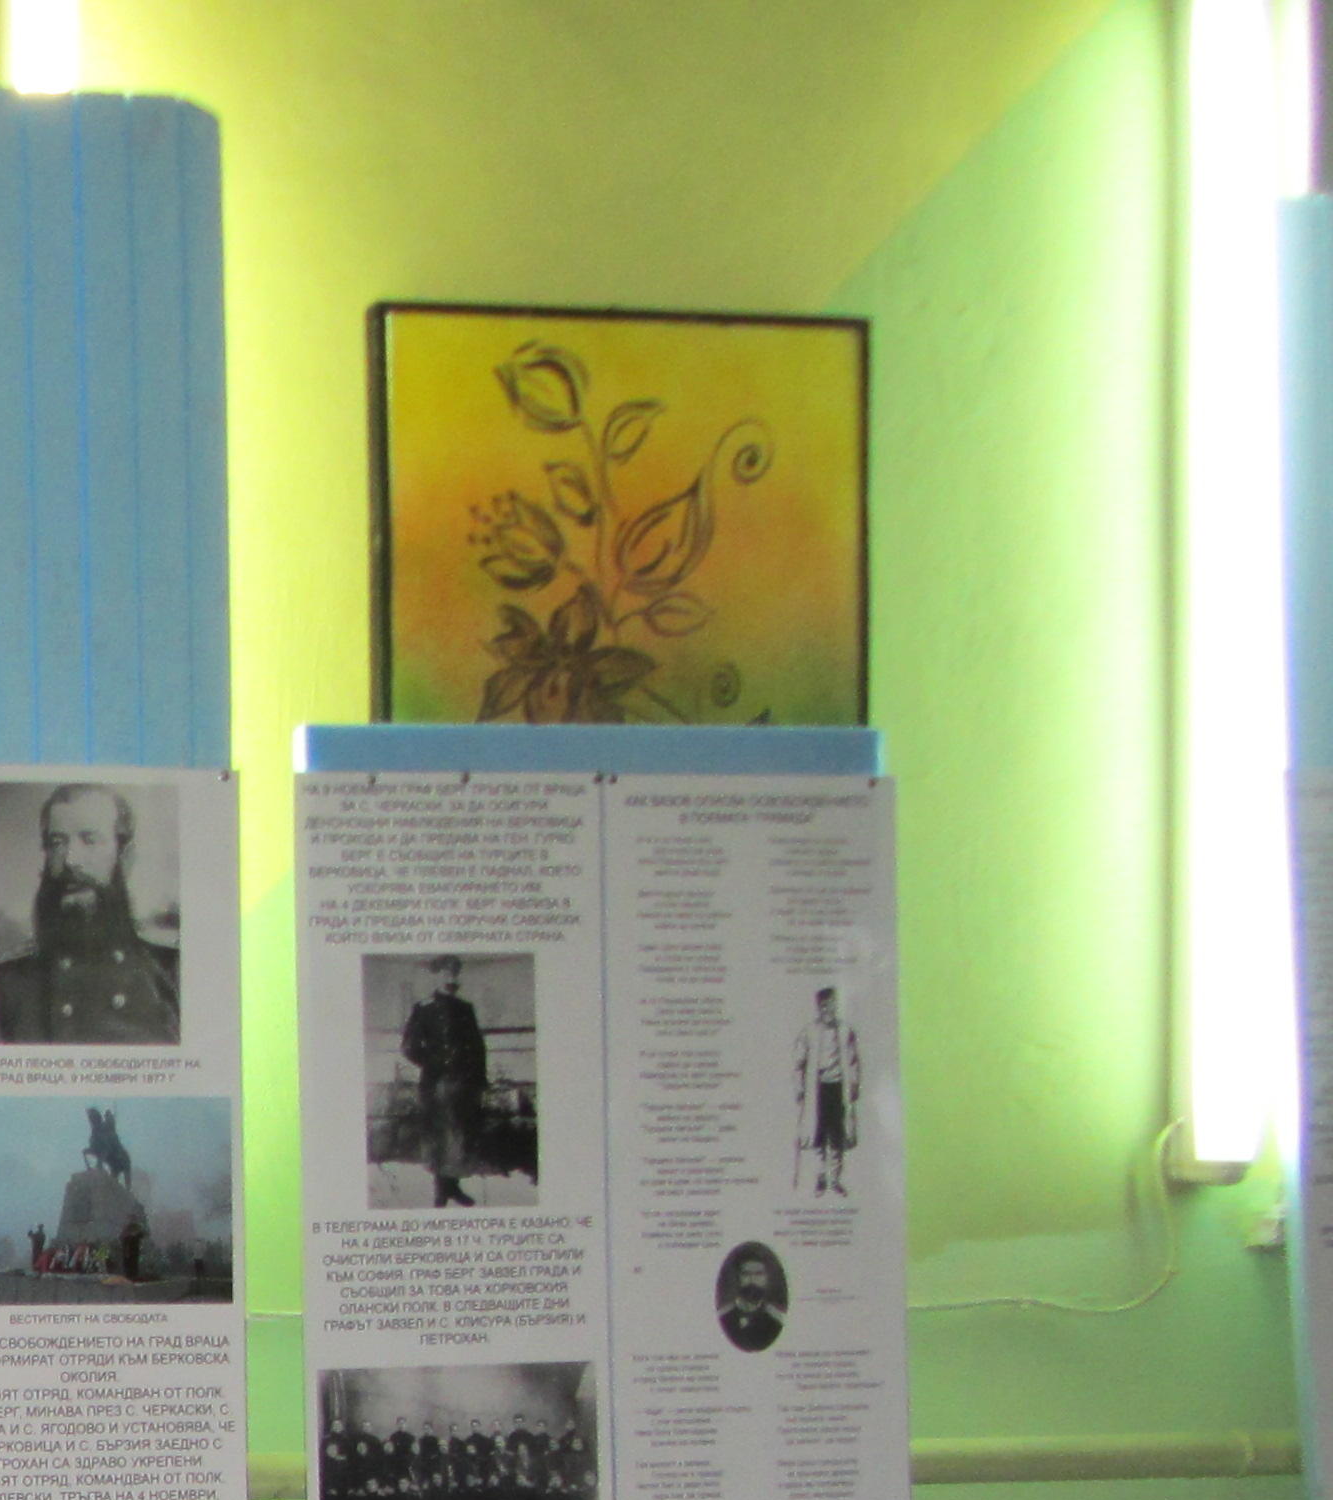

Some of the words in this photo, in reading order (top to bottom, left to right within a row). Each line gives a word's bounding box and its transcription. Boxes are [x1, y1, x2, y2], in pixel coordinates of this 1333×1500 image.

[9, 1313, 80, 1324] ВЕСТИТЕЛЯТ
[84, 1313, 100, 1324] НА
[102, 1312, 167, 1325] СВОБОДАТА
[126, 1336, 145, 1348] НА
[148, 1336, 182, 1349] ГРАД
[185, 1335, 230, 1349] ВРАЦА
[58, 1353, 114, 1367] ОТРЯДИ
[118, 1352, 147, 1365] КЪМ
[151, 1352, 230, 1364] БЕРКОВСКА
[51, 1457, 70, 1469] СА
[74, 1456, 127, 1470] ЗДРАВО
[130, 1455, 202, 1468] УКРЕПЕНИ
